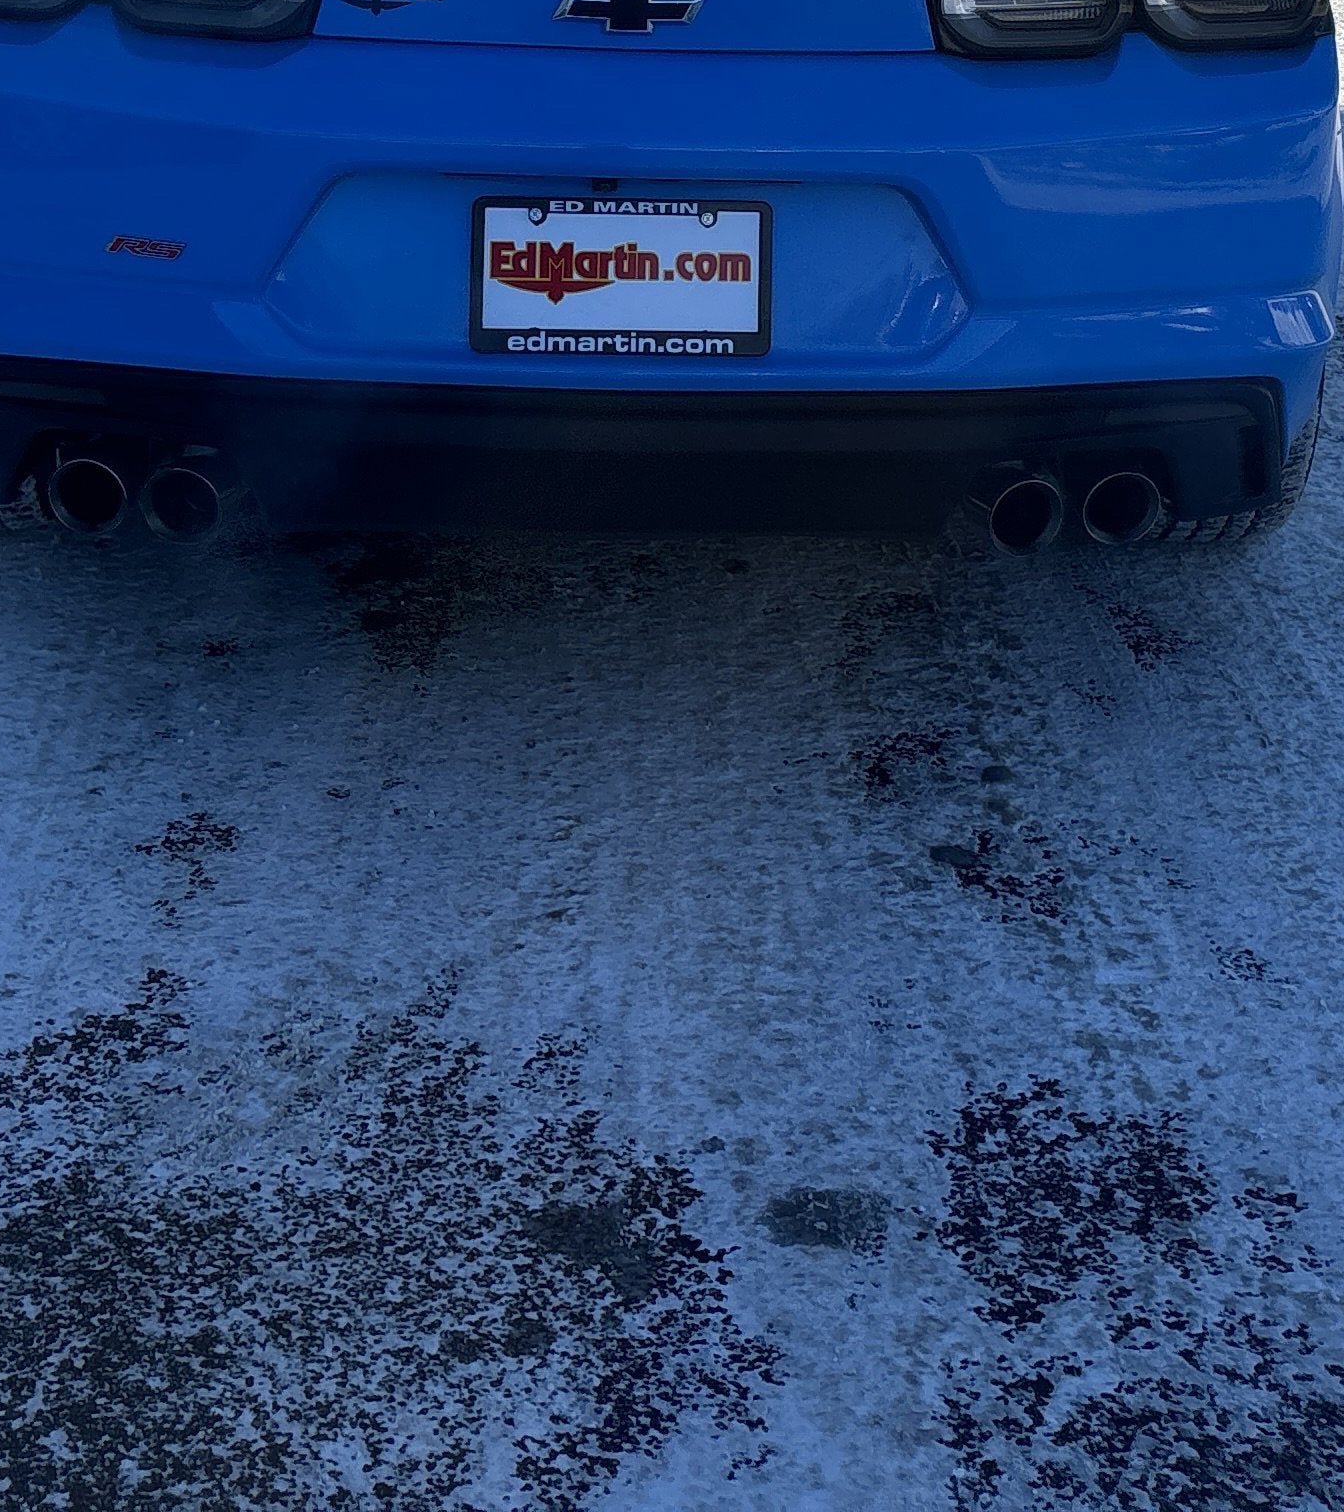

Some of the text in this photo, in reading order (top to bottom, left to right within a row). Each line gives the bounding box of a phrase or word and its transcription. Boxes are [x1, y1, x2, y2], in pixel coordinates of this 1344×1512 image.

[549, 200, 699, 214] ED MARTIN
[107, 236, 186, 260] RS
[489, 240, 752, 283] EdMartin.com
[507, 331, 734, 354] edmartin.com
